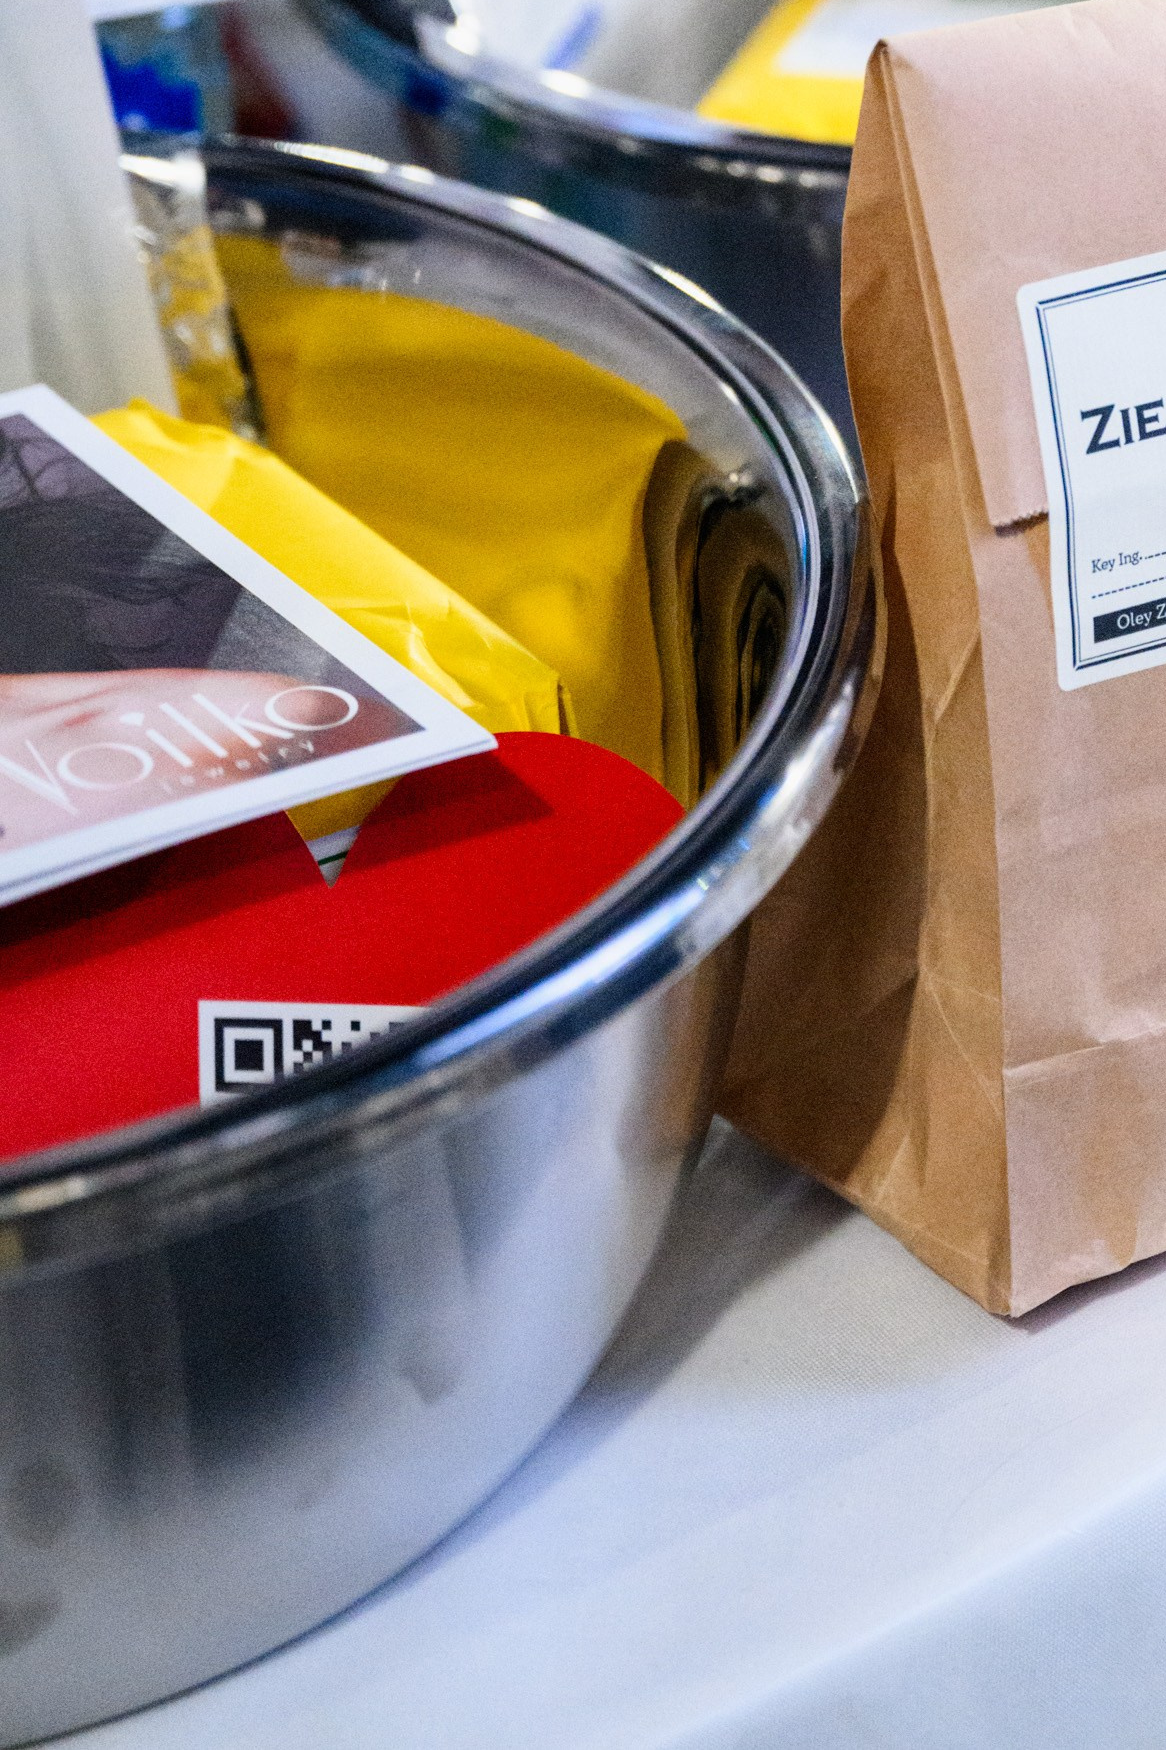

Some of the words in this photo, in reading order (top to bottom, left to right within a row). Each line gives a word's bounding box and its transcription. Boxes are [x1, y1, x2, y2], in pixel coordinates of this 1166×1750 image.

[1091, 556, 1116, 574] Key
[1118, 551, 1144, 567] Ing.
[1116, 609, 1153, 631] Oley
